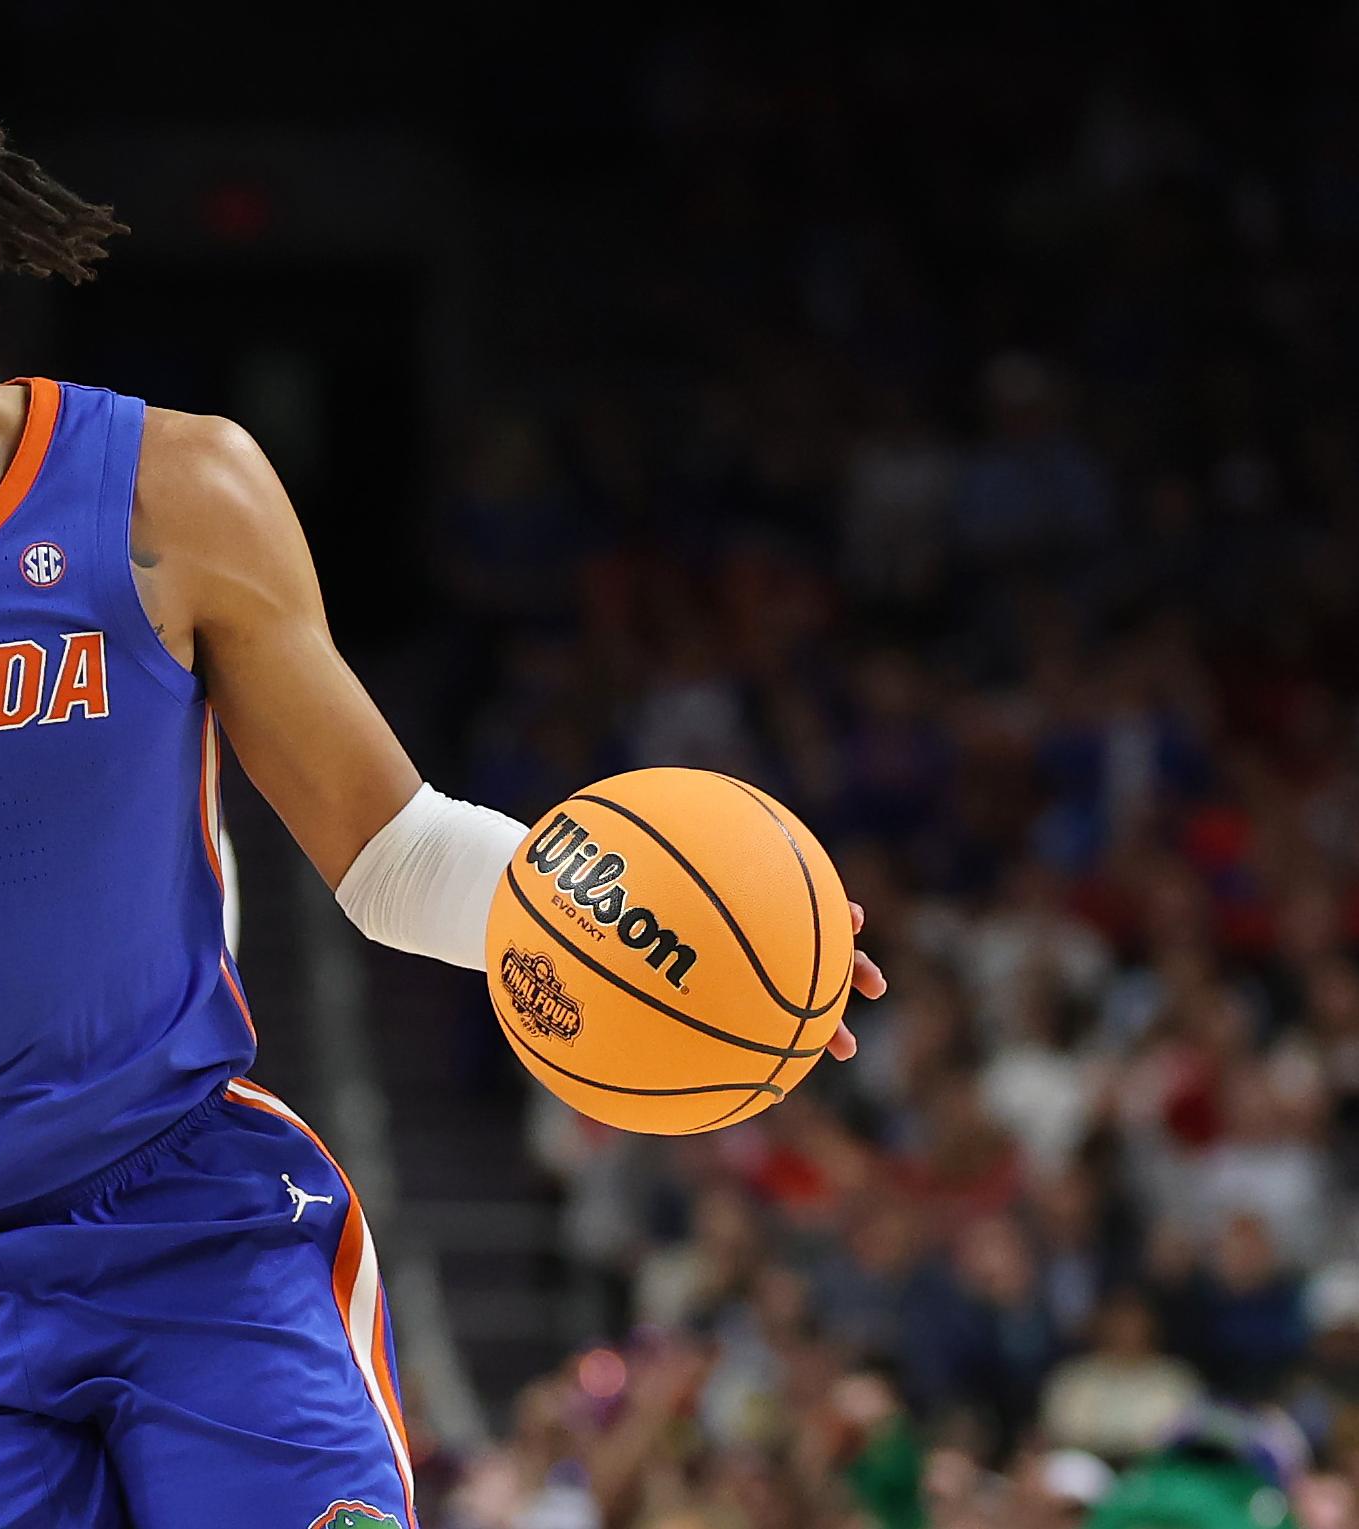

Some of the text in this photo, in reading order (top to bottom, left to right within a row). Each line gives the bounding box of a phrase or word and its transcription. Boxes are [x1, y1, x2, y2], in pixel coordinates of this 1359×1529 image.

[24, 546, 62, 583] SEC
[526, 812, 697, 989] Wilson
[551, 895, 607, 942] EVO NXT
[503, 957, 536, 1004] FINAL
[533, 991, 579, 1031] FOUR
